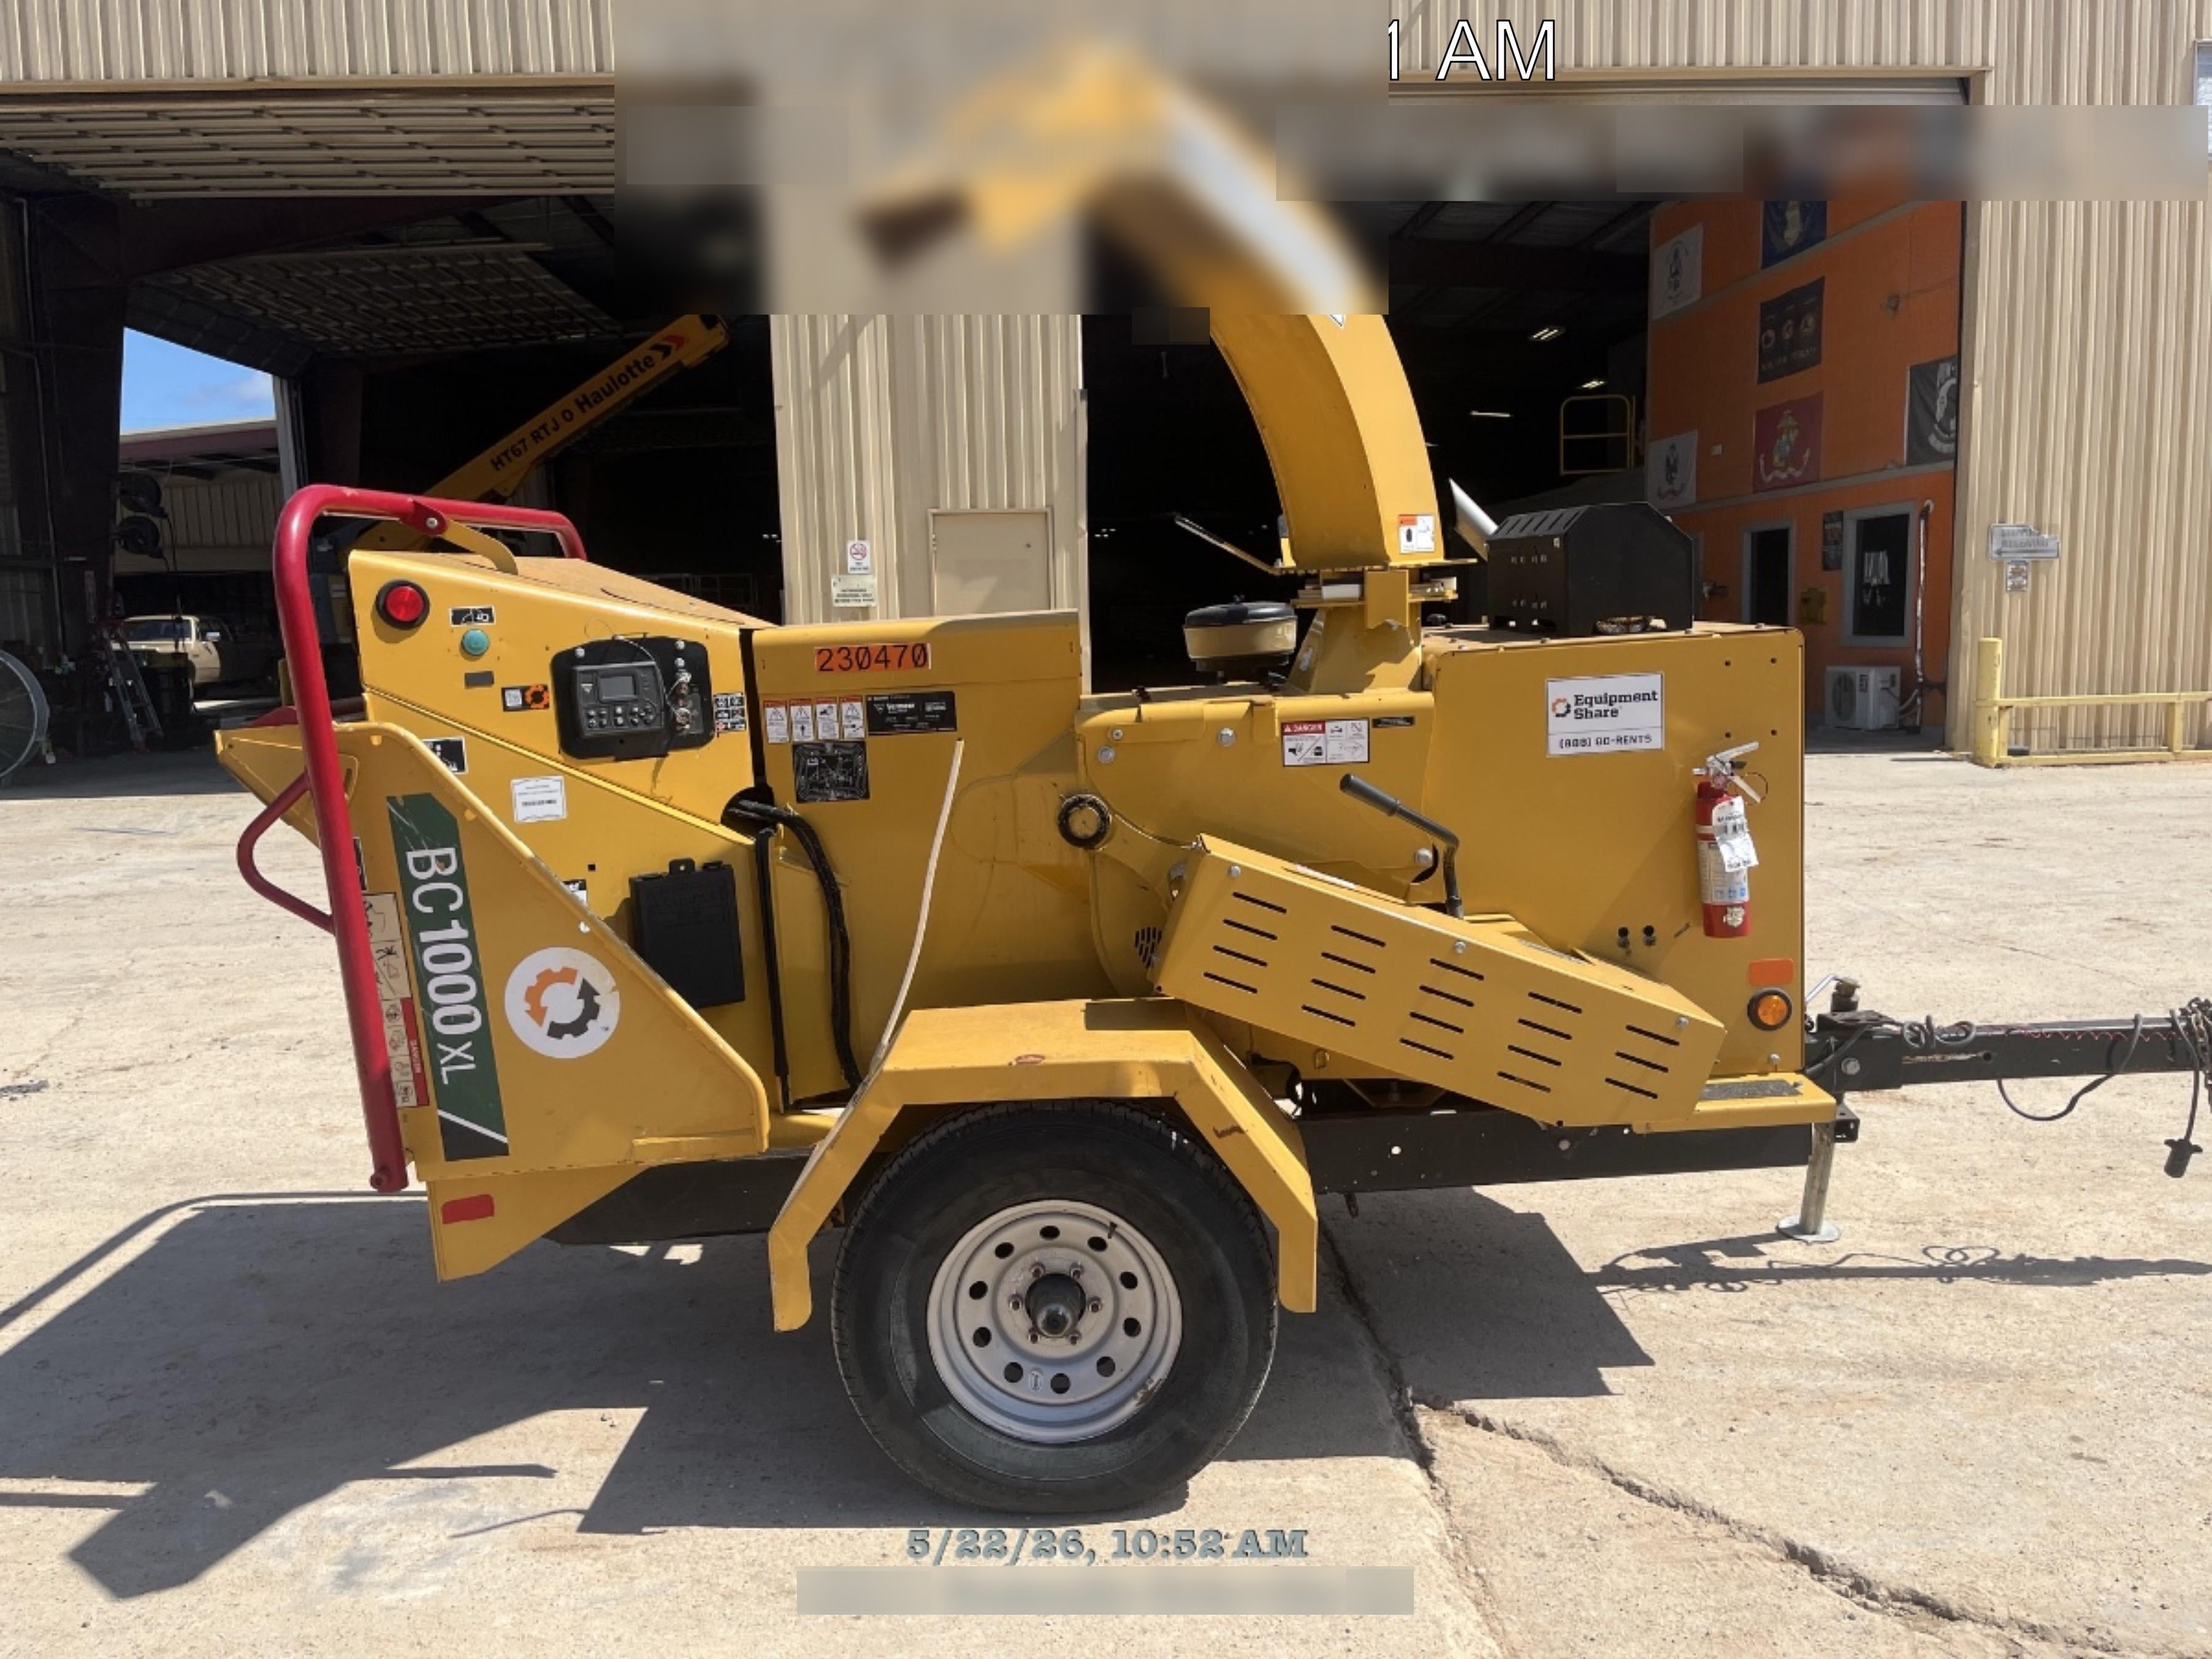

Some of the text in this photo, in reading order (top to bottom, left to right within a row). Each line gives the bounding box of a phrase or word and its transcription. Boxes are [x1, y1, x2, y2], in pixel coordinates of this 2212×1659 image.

[491, 437, 528, 471] HT67
[530, 417, 560, 444] RTJ
[575, 355, 656, 414] Haulotte
[818, 643, 928, 672] 230470
[1574, 689, 1658, 708] Equipment
[1574, 708, 1619, 720] Share
[1293, 724, 1323, 732] DANGER
